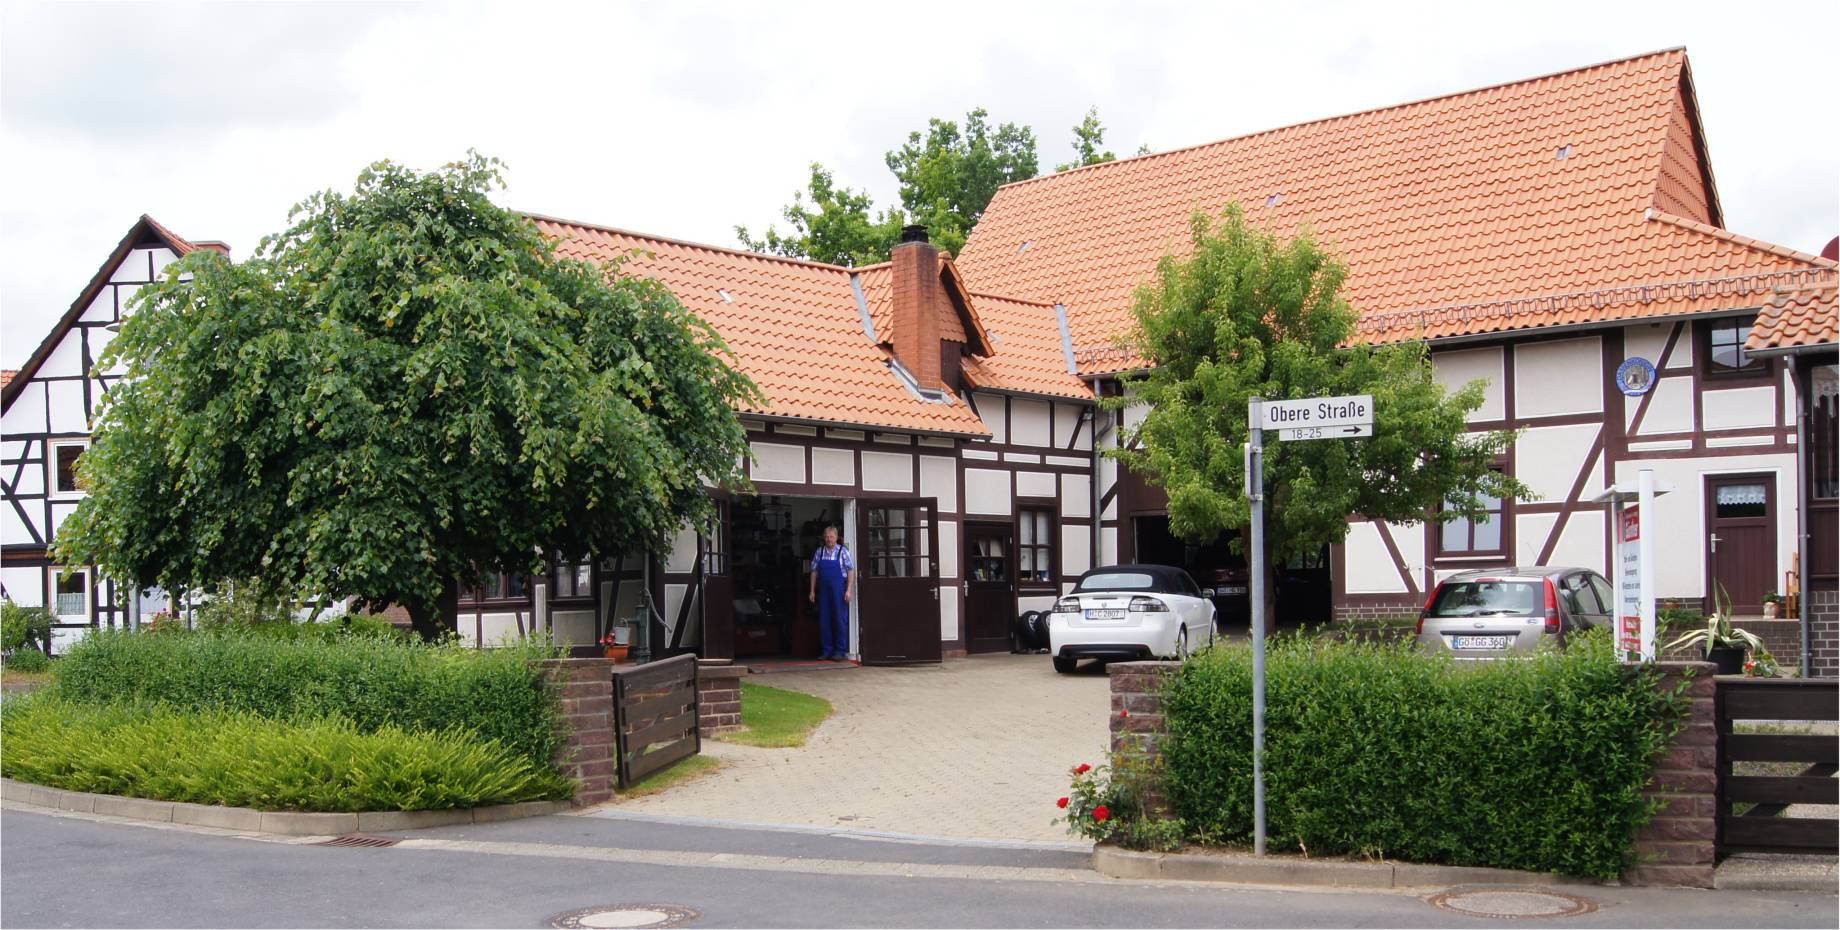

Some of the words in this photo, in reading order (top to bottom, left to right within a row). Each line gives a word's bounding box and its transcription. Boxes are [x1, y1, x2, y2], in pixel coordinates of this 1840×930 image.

[1270, 406, 1310, 422] Obere
[1318, 401, 1365, 419] Straße
[1292, 428, 1322, 439] 18-25
